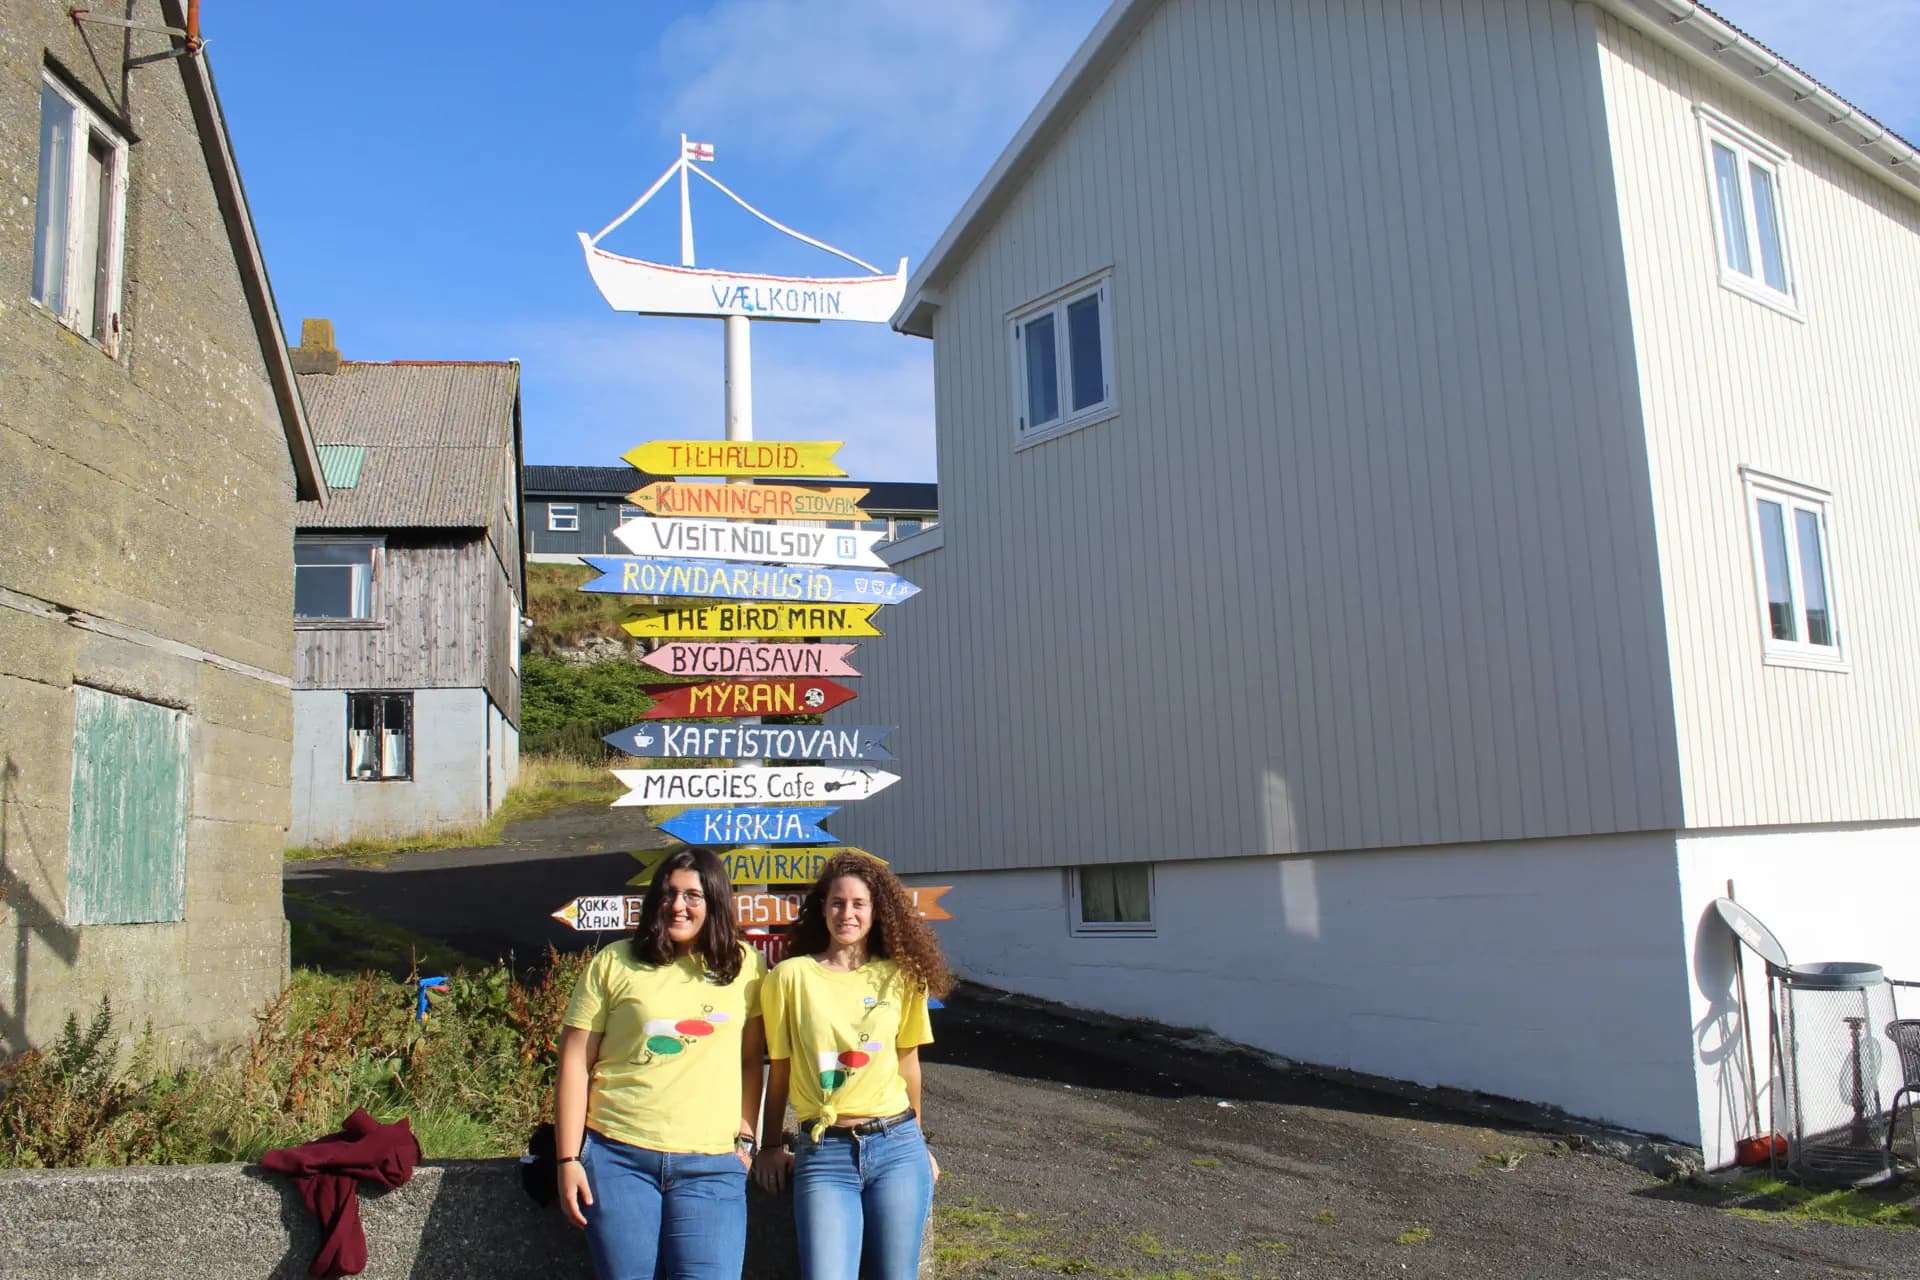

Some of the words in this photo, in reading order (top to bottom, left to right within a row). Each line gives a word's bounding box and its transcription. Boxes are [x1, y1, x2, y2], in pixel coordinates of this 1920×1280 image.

[657, 608, 708, 631] THE
[788, 608, 852, 630] MAN.
[671, 646, 828, 673] BYGDASAVN.
[662, 725, 863, 758] KAFFISTOVAN.
[767, 772, 815, 800] Cafe
[704, 810, 810, 842] KIRKJA.
[610, 901, 618, 911] &
